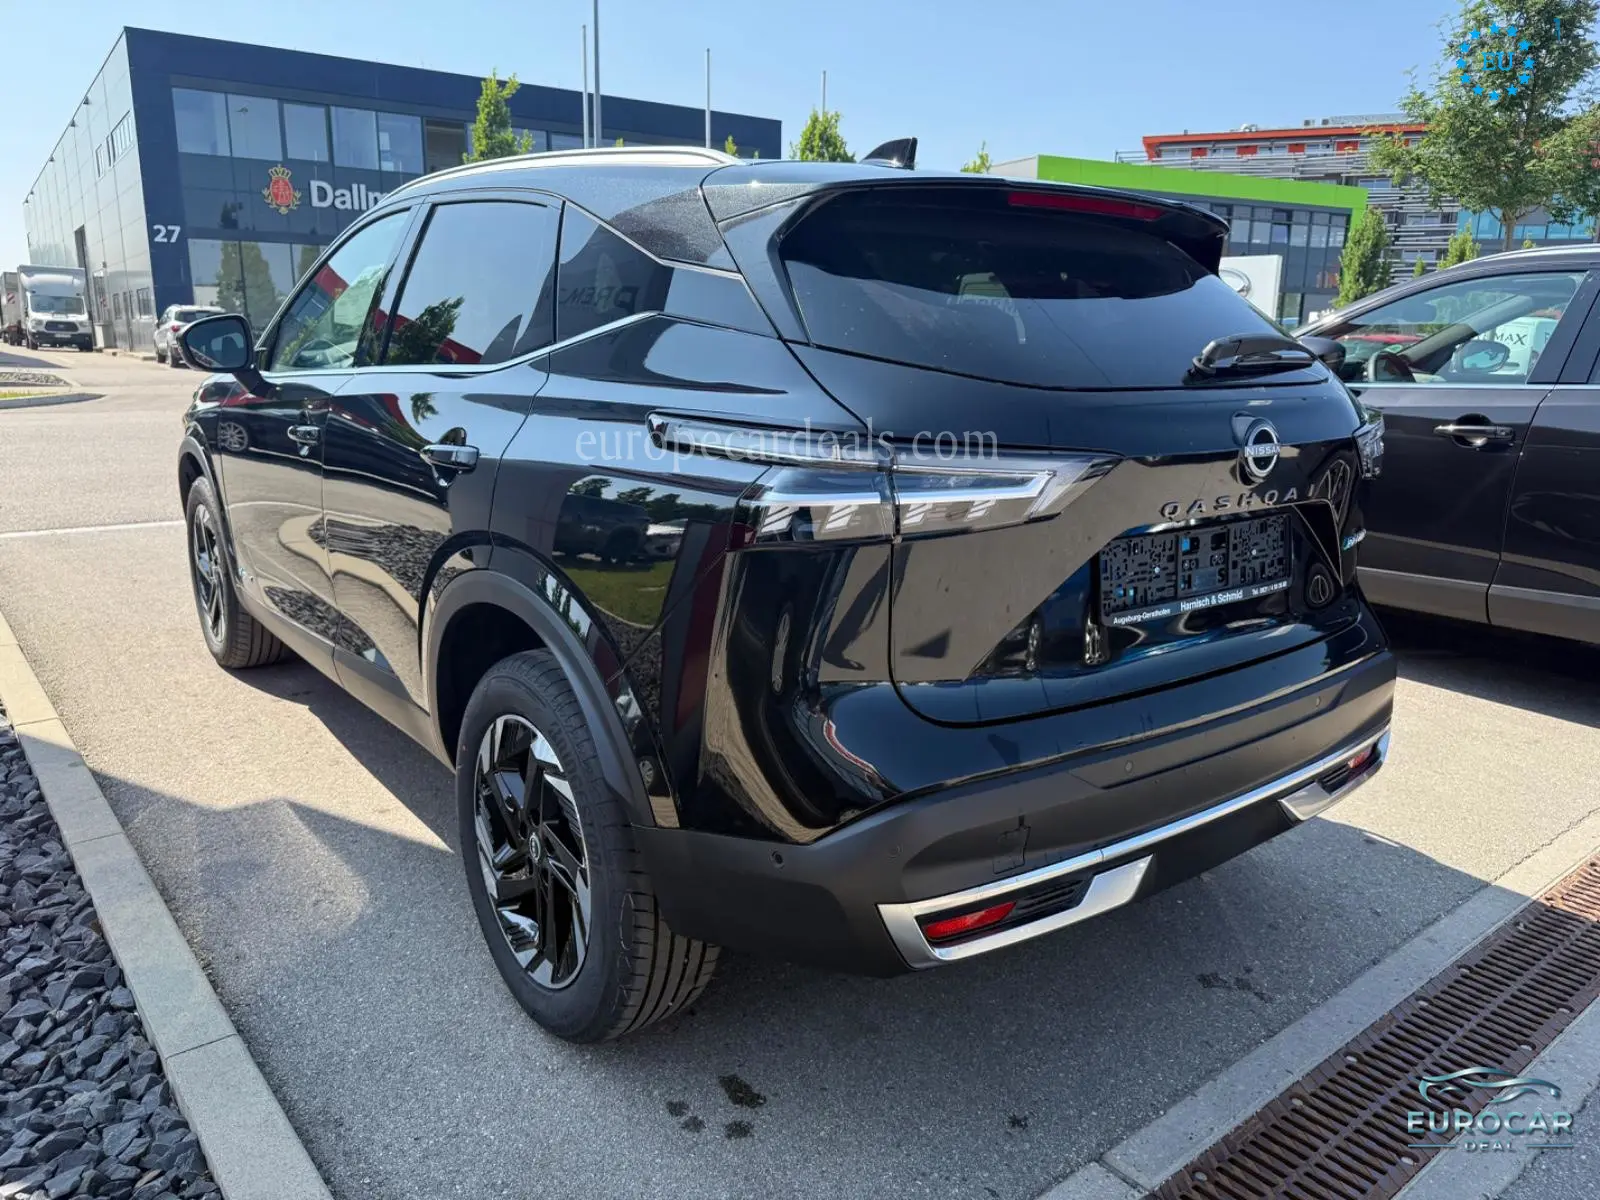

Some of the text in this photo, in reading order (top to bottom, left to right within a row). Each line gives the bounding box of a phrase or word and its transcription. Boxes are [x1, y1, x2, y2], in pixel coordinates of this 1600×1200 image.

[152, 224, 181, 243] 27
[1246, 444, 1280, 457] NISSAN
[1160, 483, 1315, 521] QASHQAI
[1211, 593, 1217, 605] &
[1217, 589, 1243, 604] Schmid
